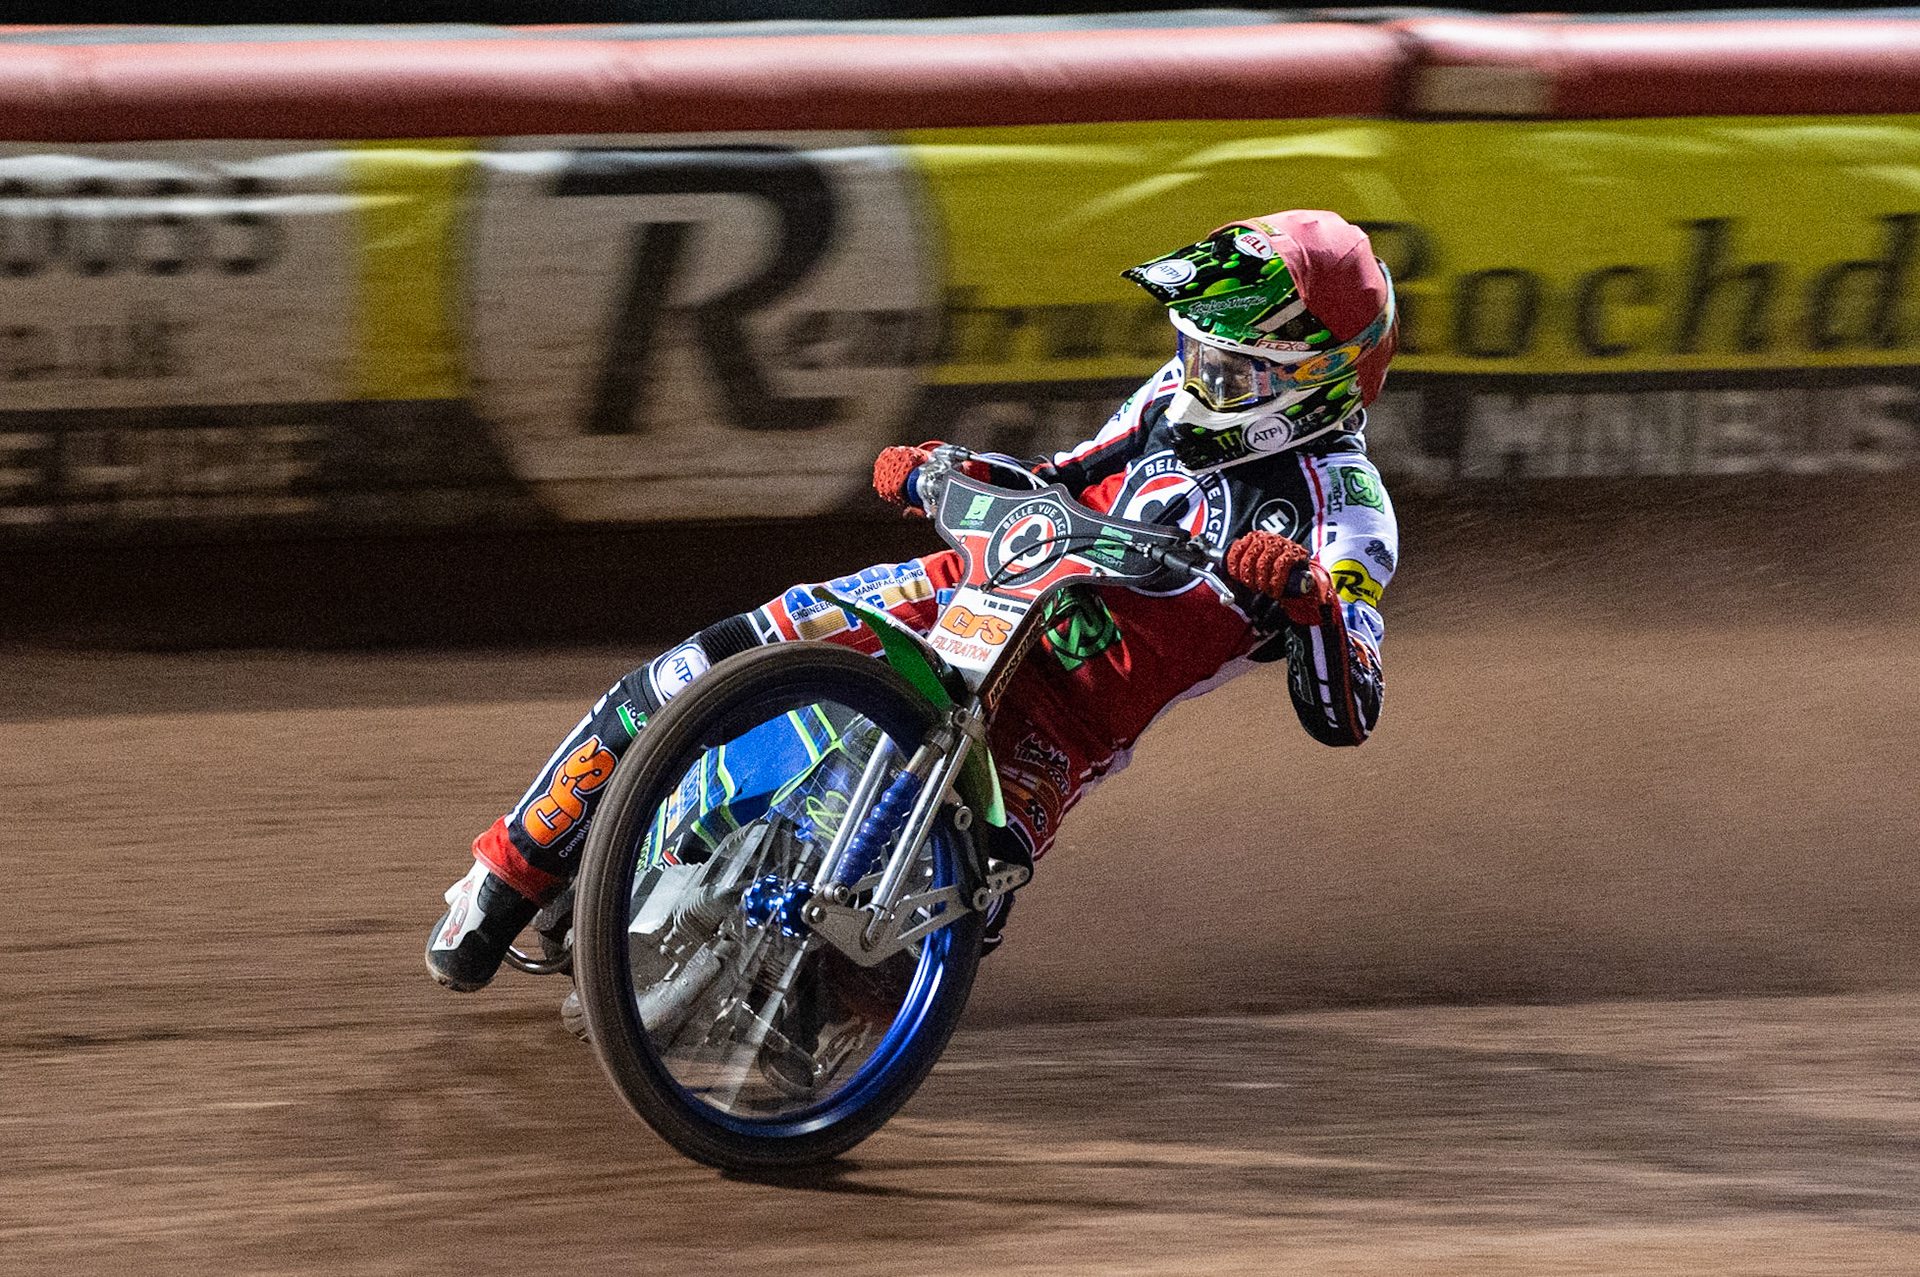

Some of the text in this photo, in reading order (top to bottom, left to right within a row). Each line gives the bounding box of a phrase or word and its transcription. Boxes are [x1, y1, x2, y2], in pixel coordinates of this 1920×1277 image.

[1241, 235, 1266, 255] BELL
[1253, 426, 1283, 446] ATPI
[1003, 506, 1034, 530] BELLE
[1038, 507, 1056, 519] VUE
[1205, 507, 1223, 544] ACE
[940, 605, 1013, 646] CFS
[931, 635, 992, 663] FILTRATION
[672, 656, 693, 684] ATP
[522, 735, 619, 848] CFS
